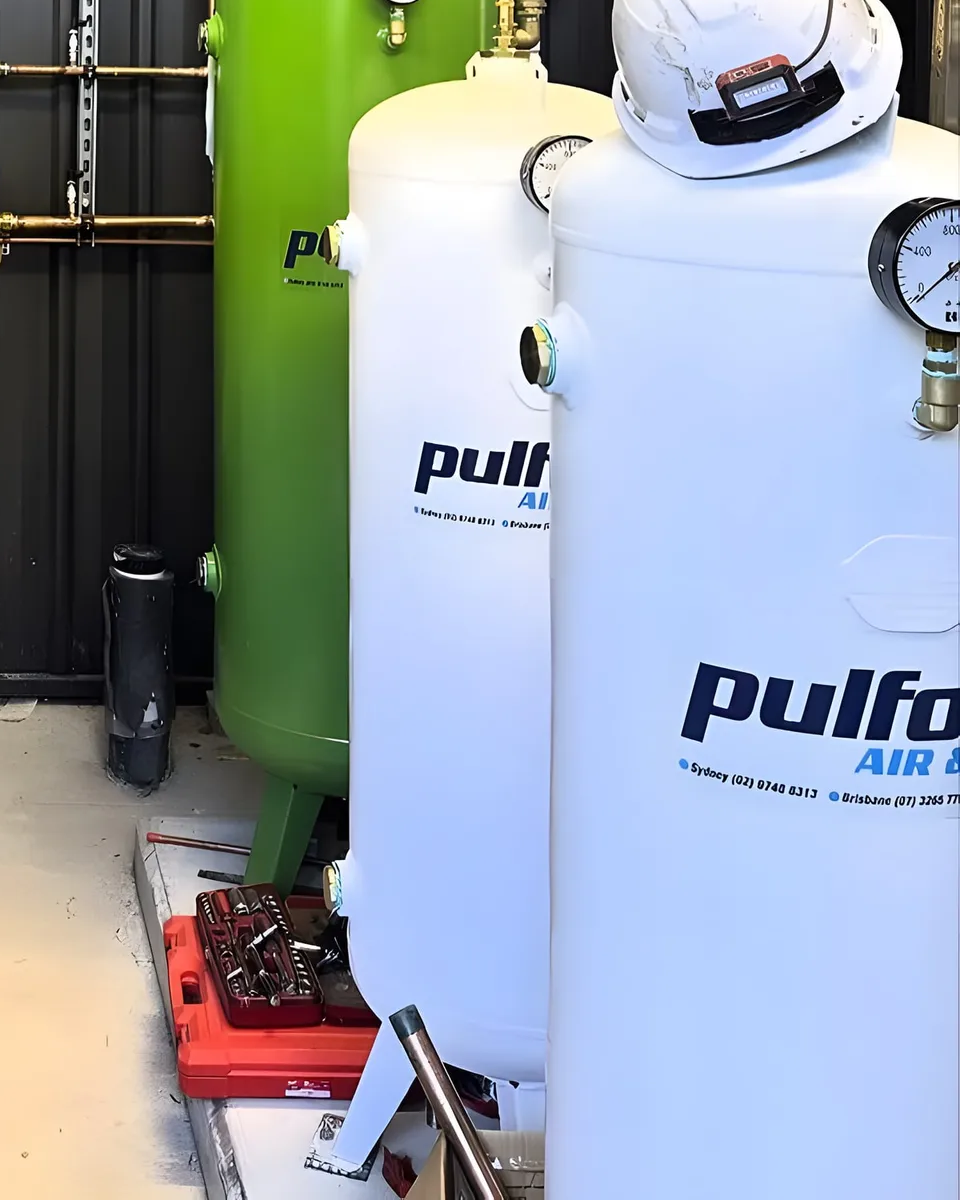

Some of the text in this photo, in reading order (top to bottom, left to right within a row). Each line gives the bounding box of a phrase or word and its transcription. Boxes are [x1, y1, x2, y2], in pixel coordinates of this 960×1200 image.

[681, 661, 960, 743] pulfo
[854, 747, 935, 776] AIR
[894, 795, 916, 808] (07)
